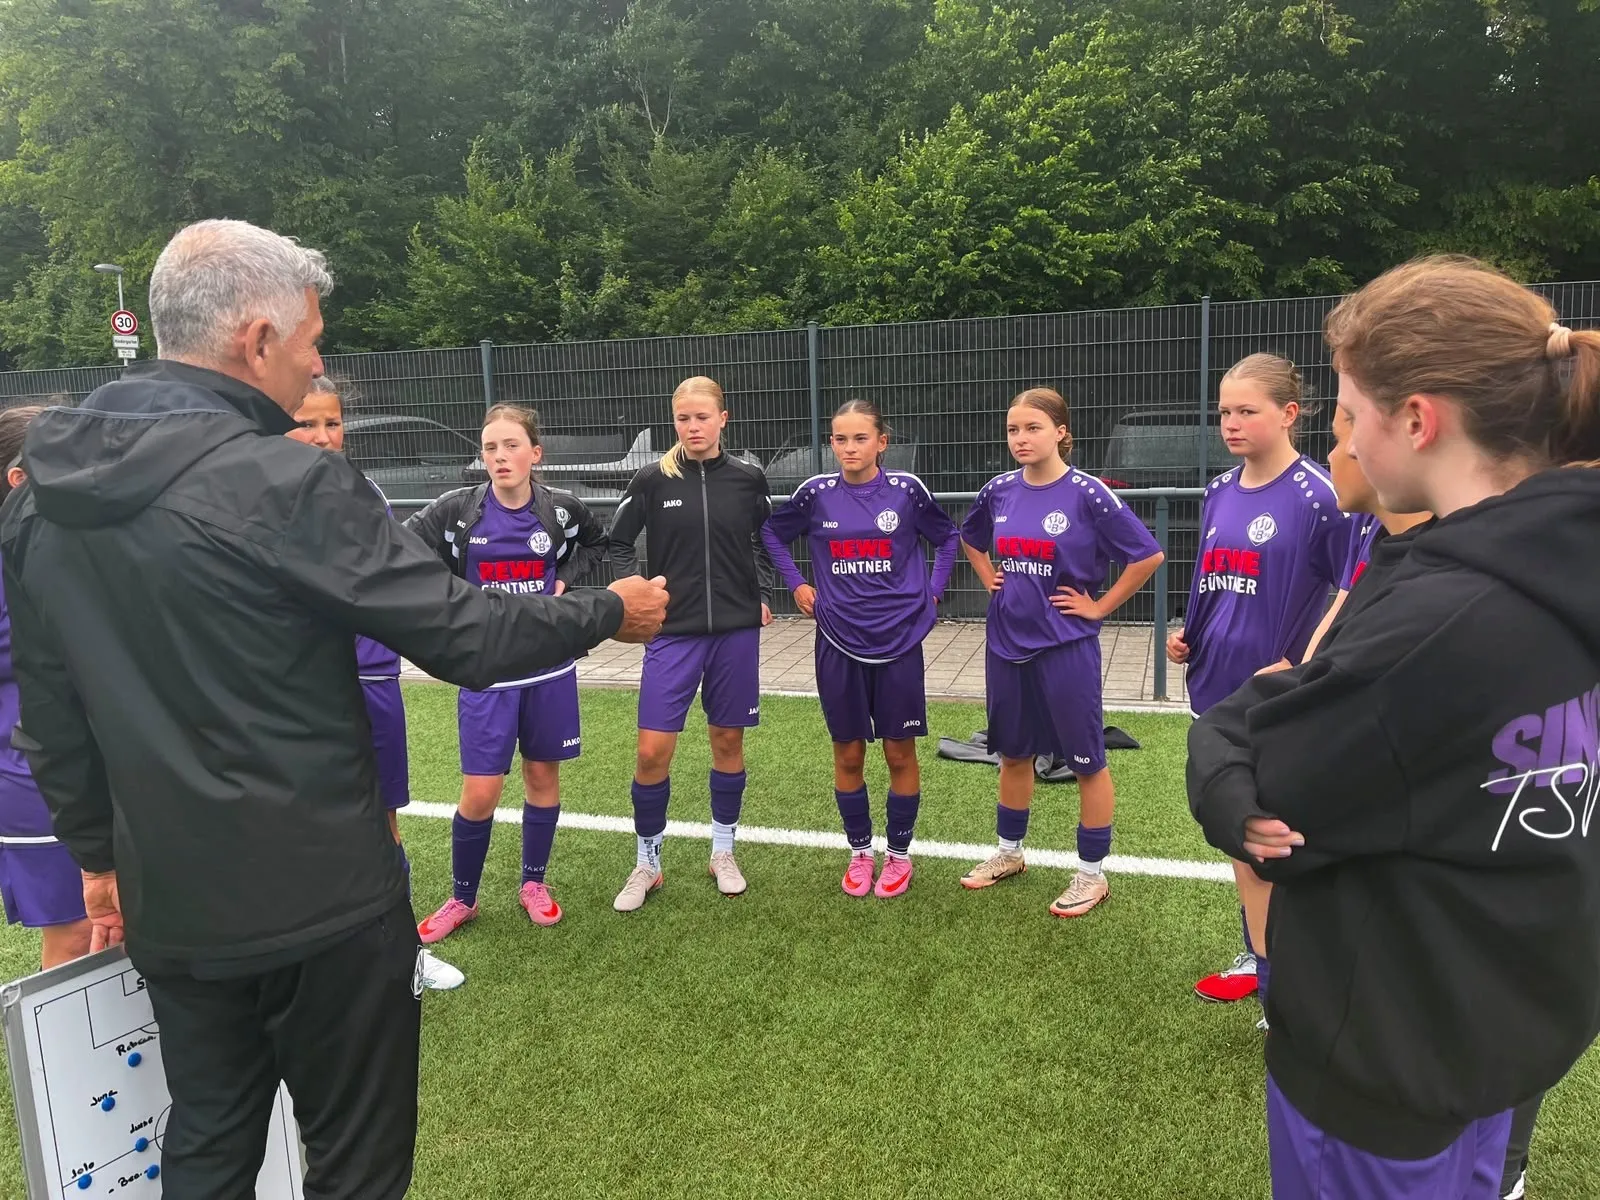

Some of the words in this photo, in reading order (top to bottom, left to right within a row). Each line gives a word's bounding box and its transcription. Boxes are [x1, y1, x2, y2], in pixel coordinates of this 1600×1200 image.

[117, 317, 132, 328] 30
[663, 499, 682, 508] JAKO
[822, 521, 839, 529] JAKO
[469, 536, 488, 545] JAKO
[829, 538, 893, 559] REWE
[996, 535, 1057, 560] REWE
[478, 560, 545, 582] REWE
[831, 559, 892, 575] GÜNTNER
[1001, 557, 1053, 577] GÜNTNER
[1199, 572, 1257, 595] GÜNTNER
[902, 719, 921, 729] JAKO
[562, 736, 581, 748] JAKO
[1073, 754, 1091, 764] JAKO
[524, 864, 545, 872] JAKO
